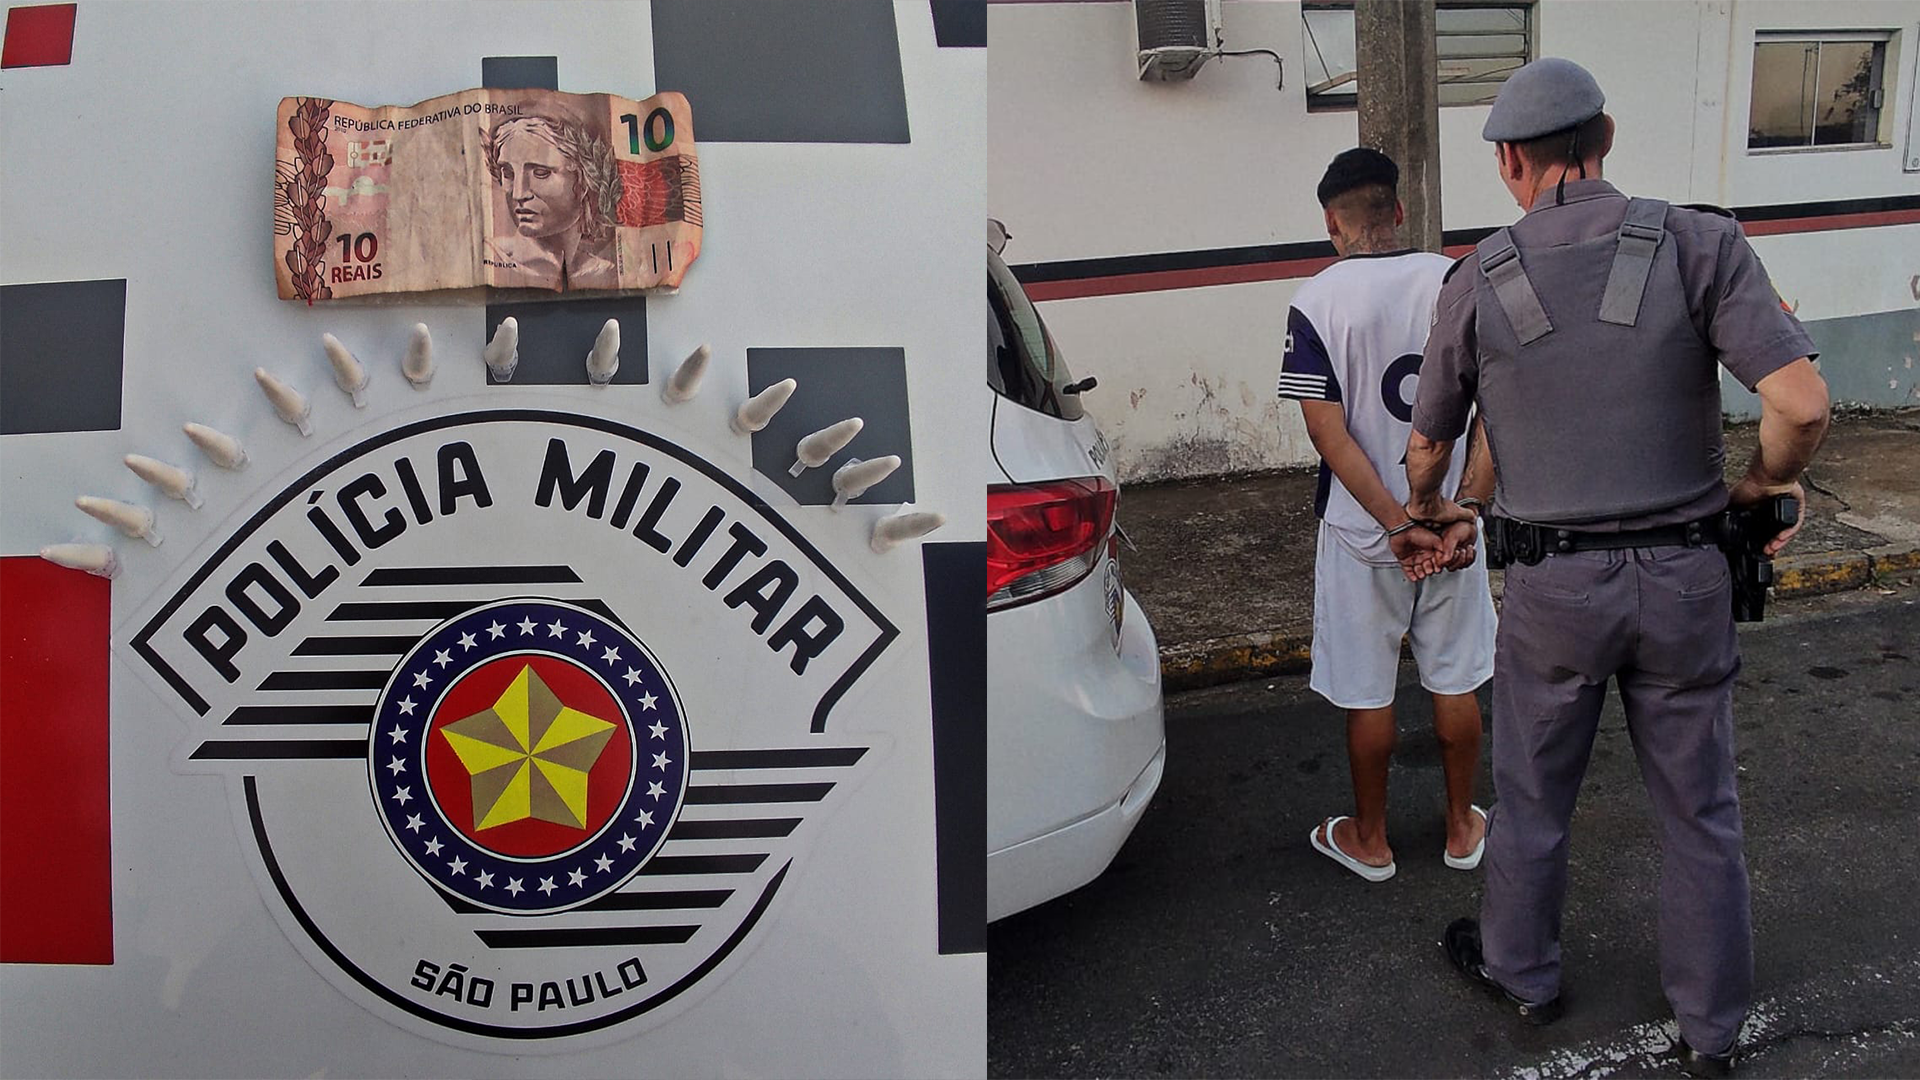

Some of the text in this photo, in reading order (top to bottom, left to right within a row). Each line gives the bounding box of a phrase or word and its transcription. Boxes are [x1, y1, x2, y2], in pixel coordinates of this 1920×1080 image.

[334, 102, 524, 132] REPÚBLICA FEDERATIVA DO BRASIL
[620, 106, 675, 155] 10
[336, 232, 378, 263] 10
[331, 263, 383, 284] REAIS
[183, 438, 845, 684] POLÍCIA MILITAR
[410, 957, 649, 1012] SÃO PAULO
